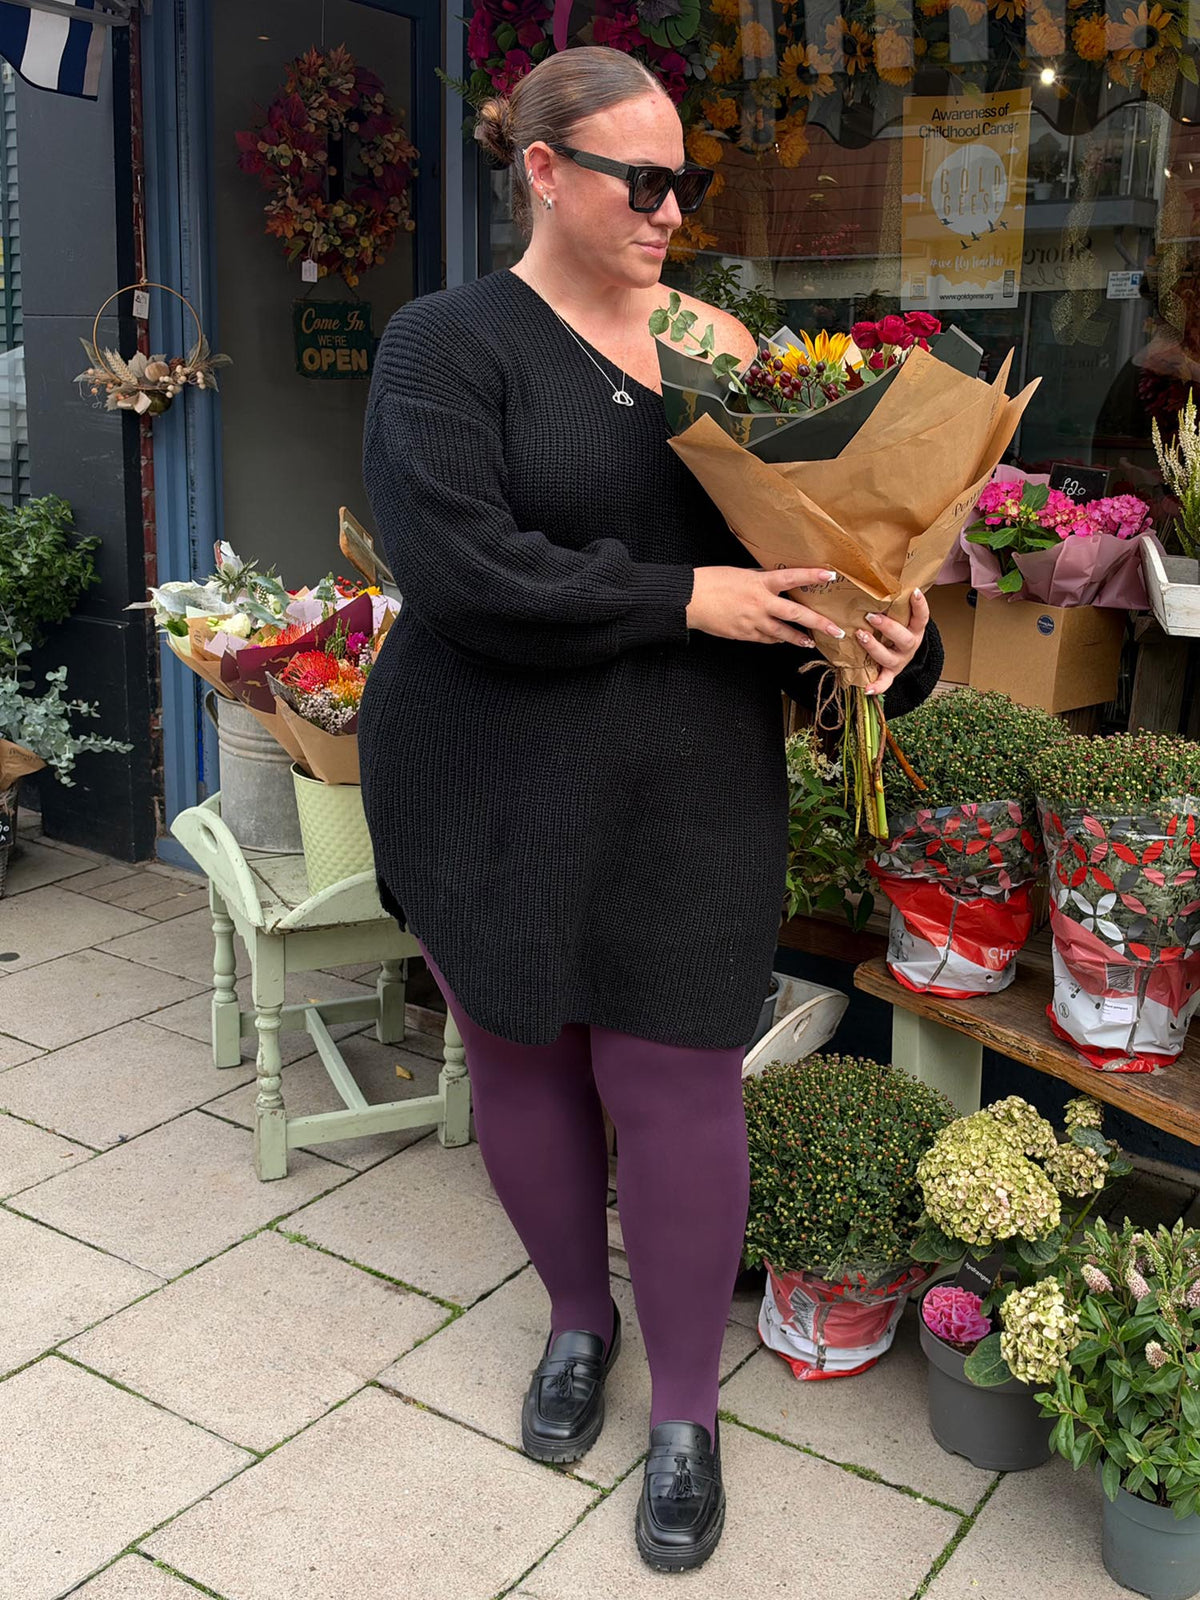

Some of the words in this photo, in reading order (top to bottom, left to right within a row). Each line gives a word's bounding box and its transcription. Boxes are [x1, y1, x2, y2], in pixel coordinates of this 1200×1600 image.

[931, 106, 997, 121] Awareness
[998, 102, 1010, 117] of
[919, 124, 980, 139] Childhood
[982, 121, 1019, 136] Cancer
[941, 165, 1001, 194] GOLD
[943, 192, 1001, 217] GEESE
[939, 293, 994, 301] www.goldgeese.org
[301, 307, 341, 334] Come
[344, 310, 366, 331] In
[317, 335, 348, 347] WE'RE
[302, 347, 368, 371] OPEN
[1059, 477, 1087, 496] £20
